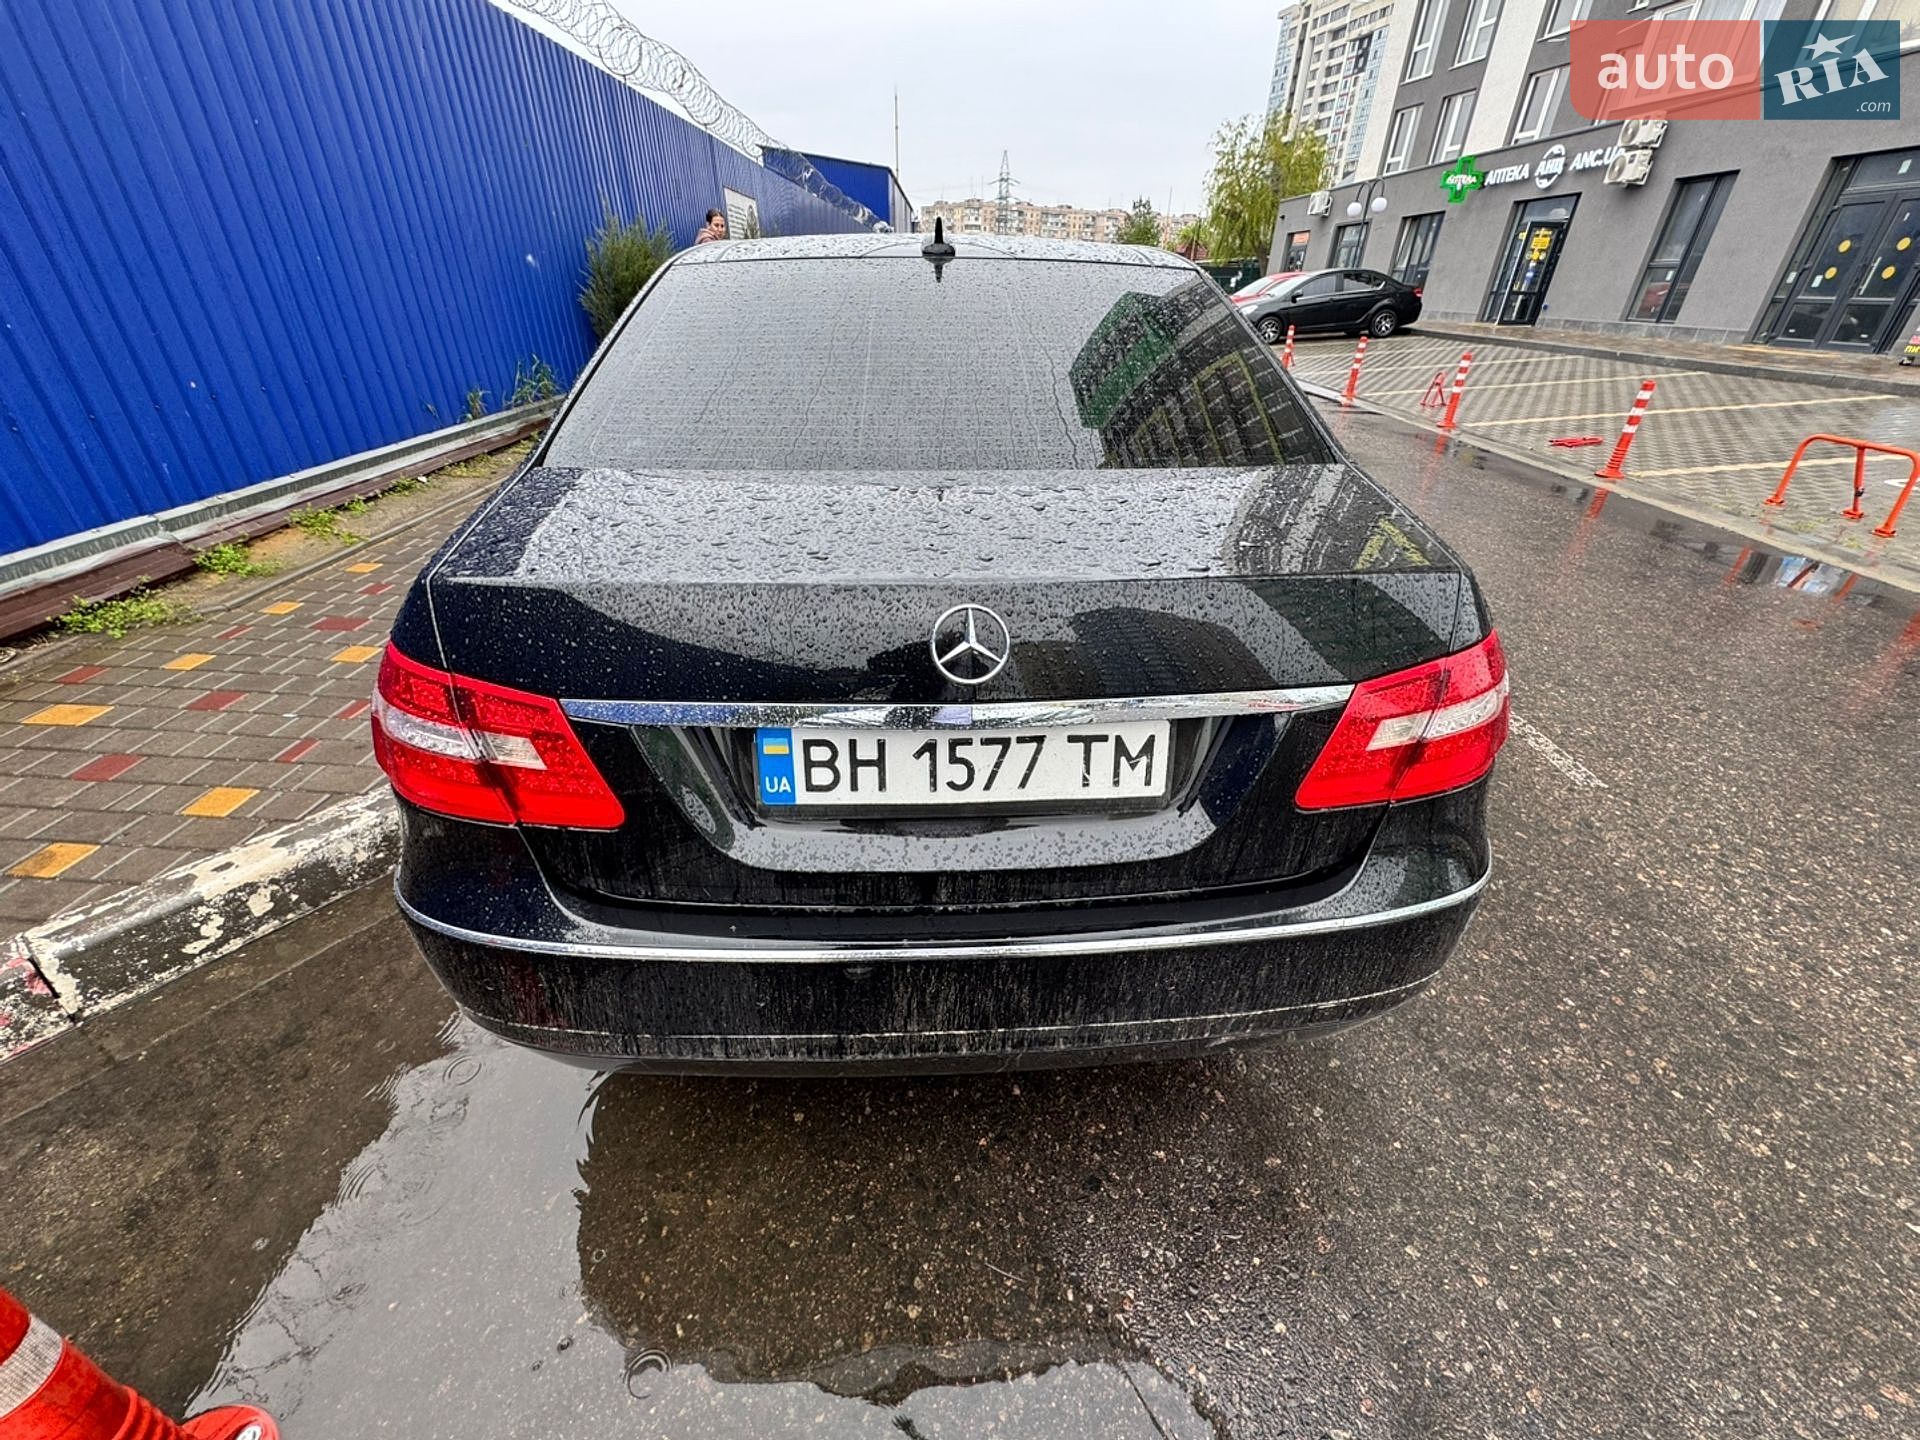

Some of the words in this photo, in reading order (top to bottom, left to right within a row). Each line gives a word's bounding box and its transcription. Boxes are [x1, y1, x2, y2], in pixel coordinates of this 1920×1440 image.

[1484, 163, 1529, 186] АПТЕКА
[803, 738, 887, 793] BH
[913, 734, 1047, 794] 1577
[1067, 734, 1156, 788] TM
[765, 775, 792, 793] UA
